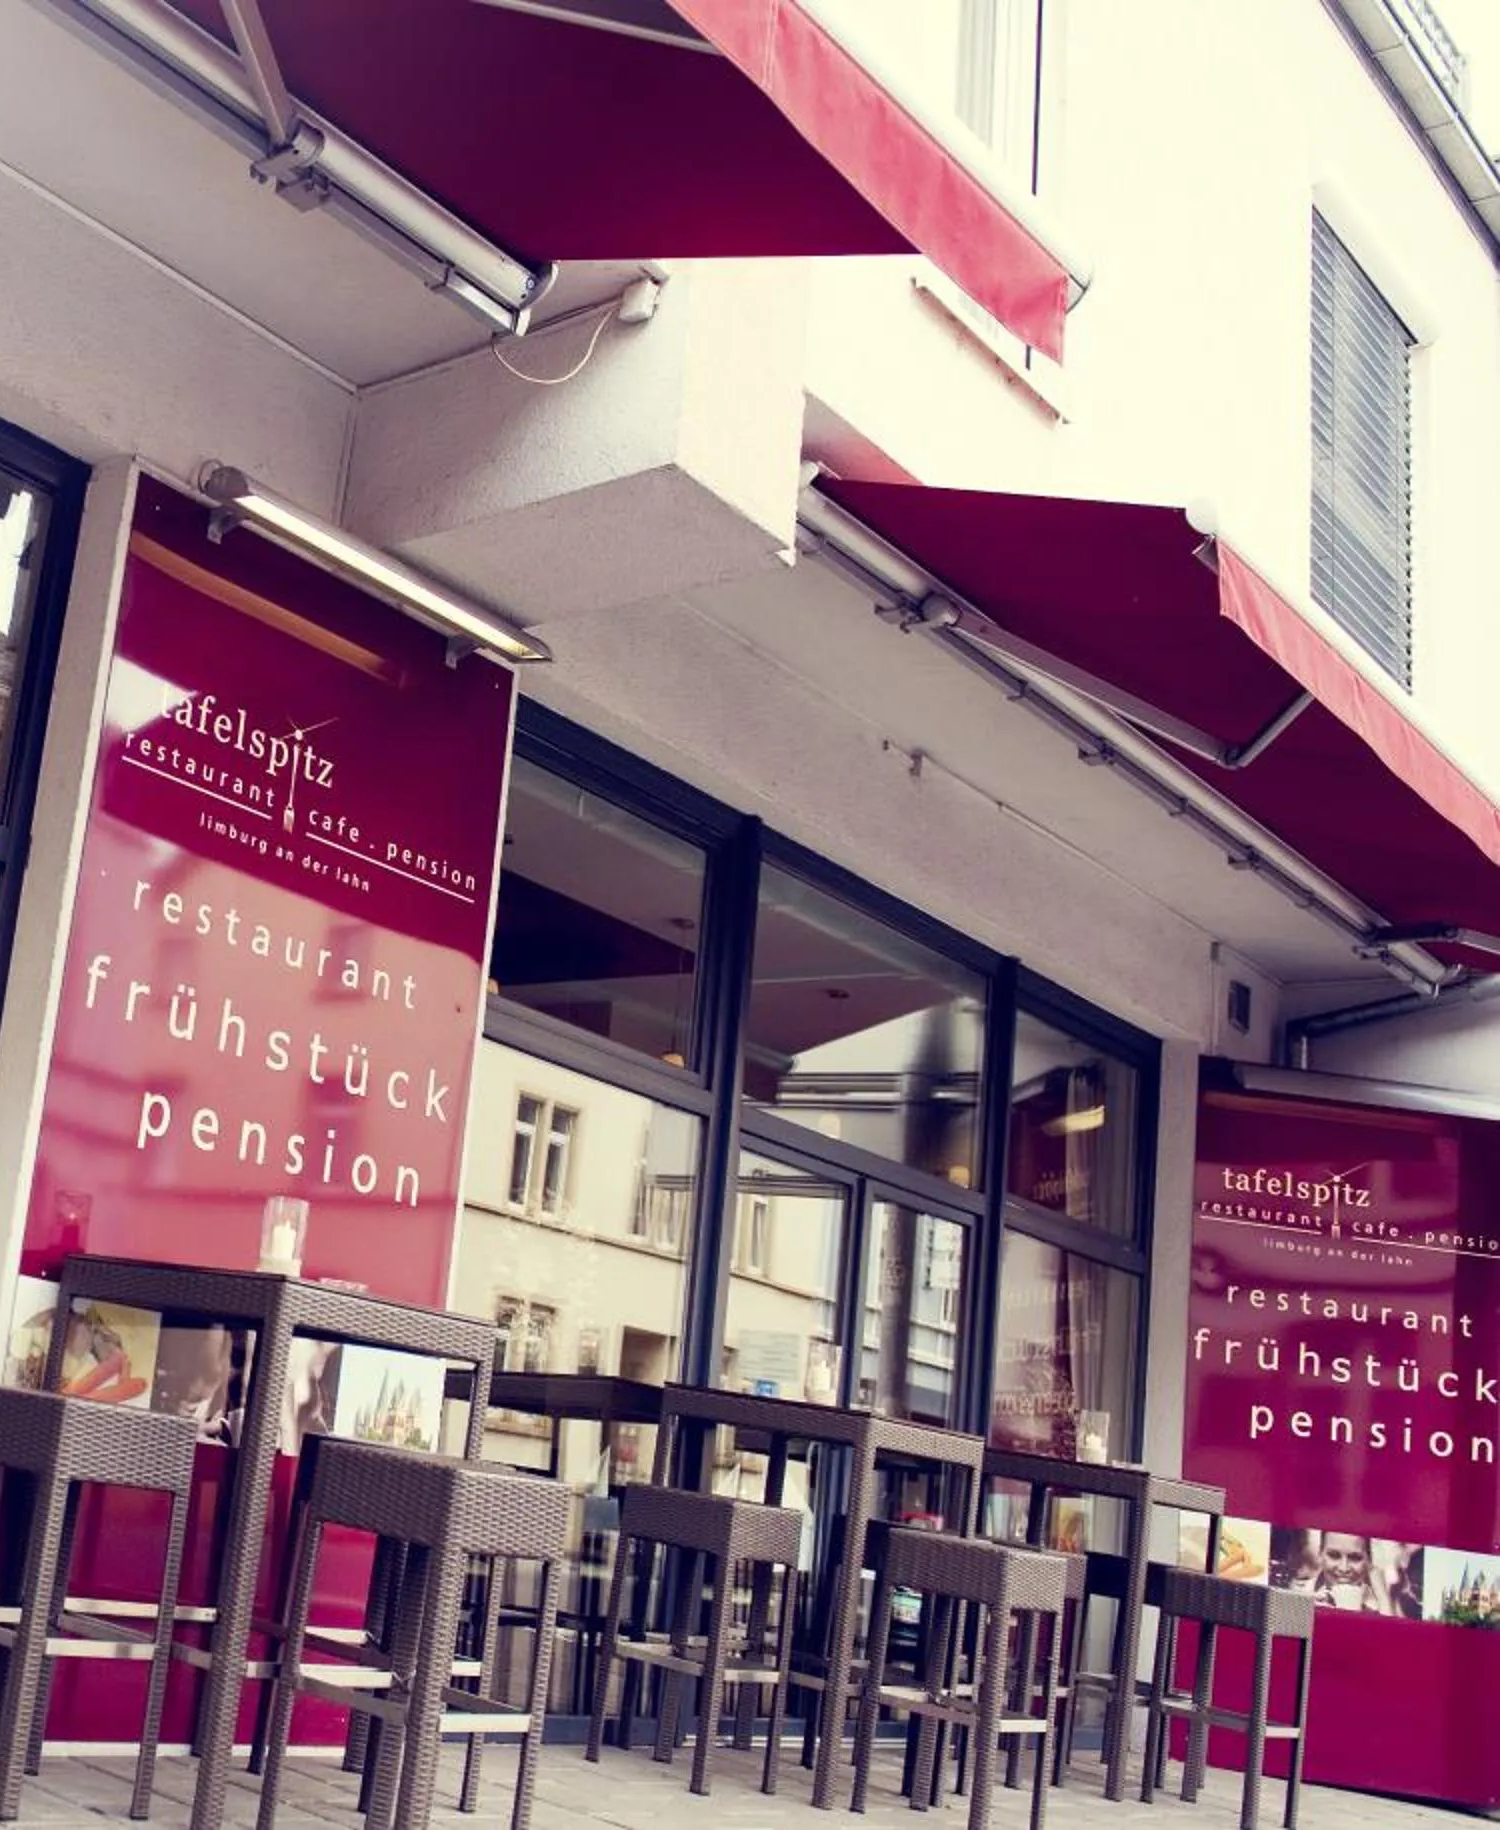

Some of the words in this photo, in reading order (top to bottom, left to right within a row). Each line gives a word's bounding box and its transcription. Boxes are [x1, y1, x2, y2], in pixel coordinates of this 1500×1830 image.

[161, 686, 335, 788] tafelspitz
[124, 730, 275, 808] restaurant
[308, 806, 361, 843] cafe
[386, 841, 477, 891] pension
[200, 813, 267, 855] limburg
[275, 846, 295, 862] an
[302, 854, 329, 876] der
[335, 867, 371, 892] lahn
[133, 879, 417, 1010] restaurant
[86, 954, 450, 1122] frühstück
[136, 1091, 421, 1207] pension
[1222, 1167, 1371, 1208] tafelspitz
[1201, 1200, 1322, 1228] restaurant
[1352, 1221, 1399, 1238] cafe
[1263, 1237, 1322, 1256] limburg
[1226, 1283, 1473, 1338] restaurant
[1193, 1328, 1499, 1403] frühstück
[1250, 1403, 1494, 1463] pension
